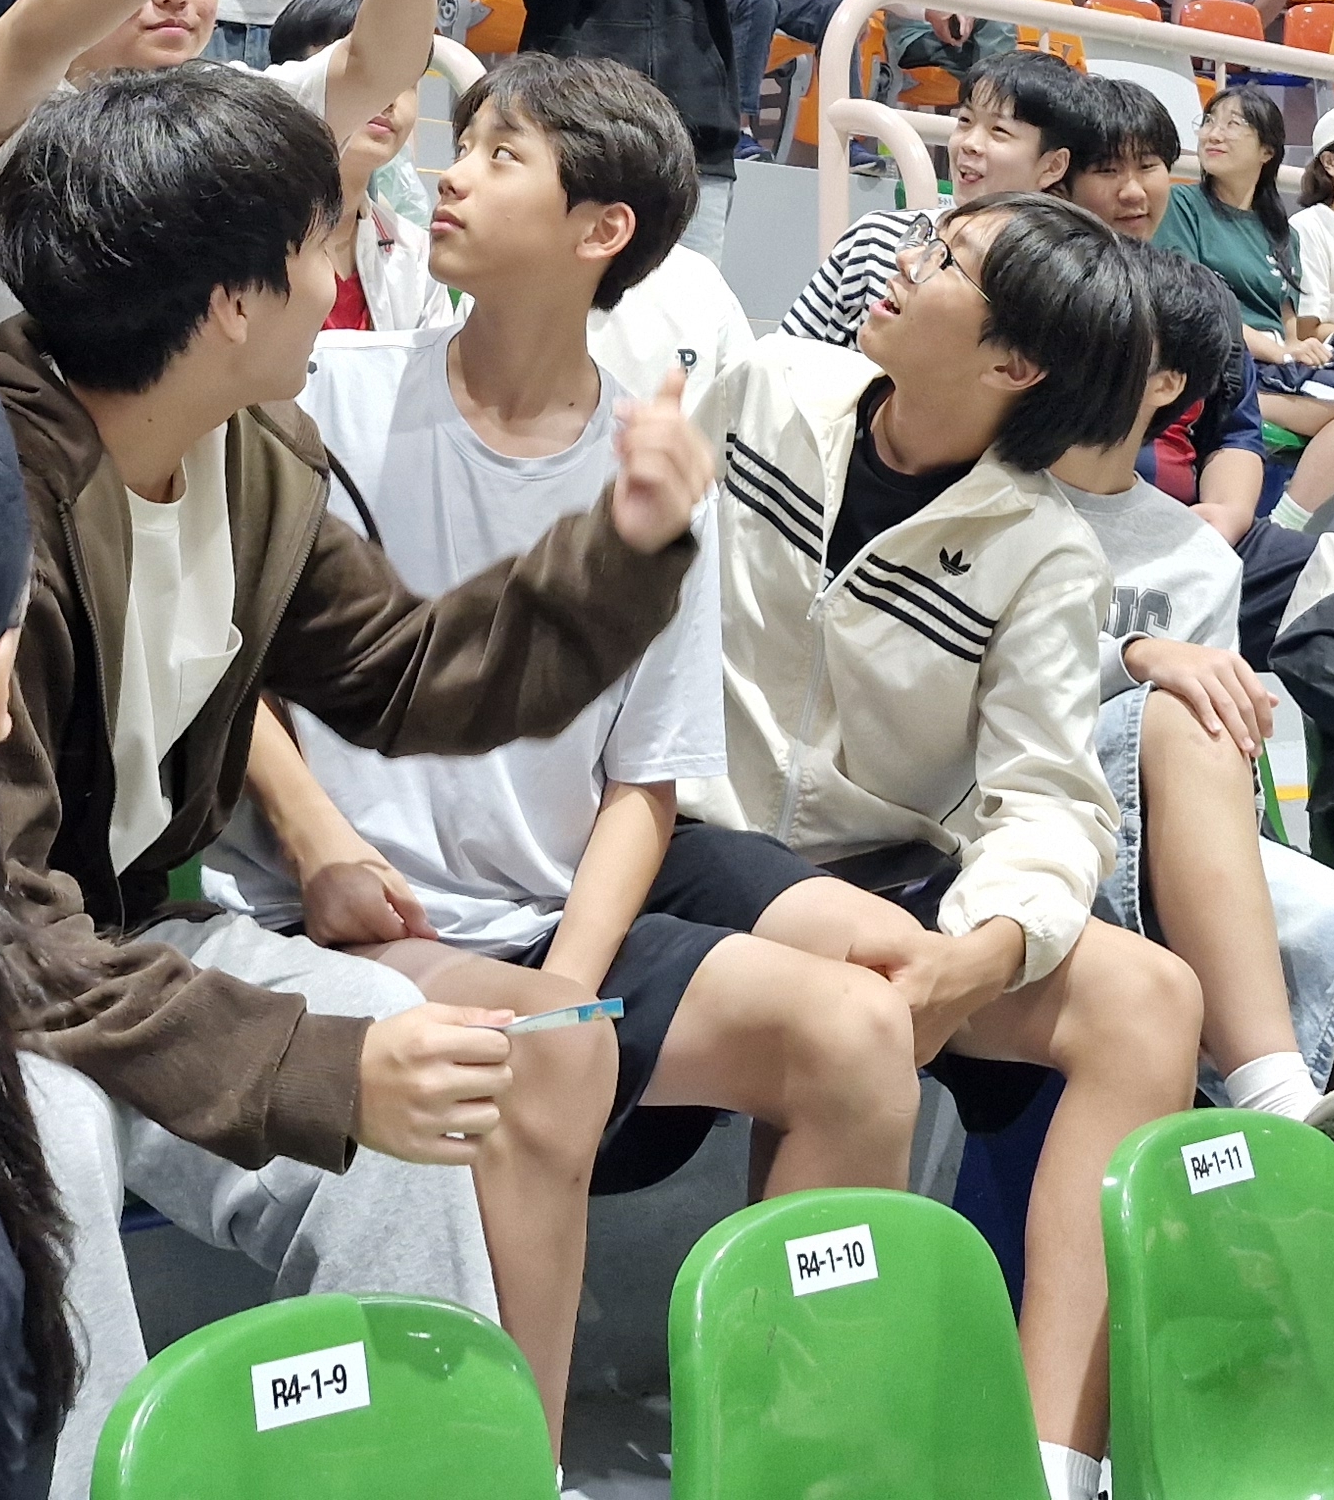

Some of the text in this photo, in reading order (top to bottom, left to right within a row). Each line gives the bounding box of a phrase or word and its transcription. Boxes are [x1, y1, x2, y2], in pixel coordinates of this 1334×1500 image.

[1190, 1145, 1243, 1181] R4-1-11
[796, 1240, 865, 1280] R4-1-10
[271, 1363, 348, 1410] R4-1-9
